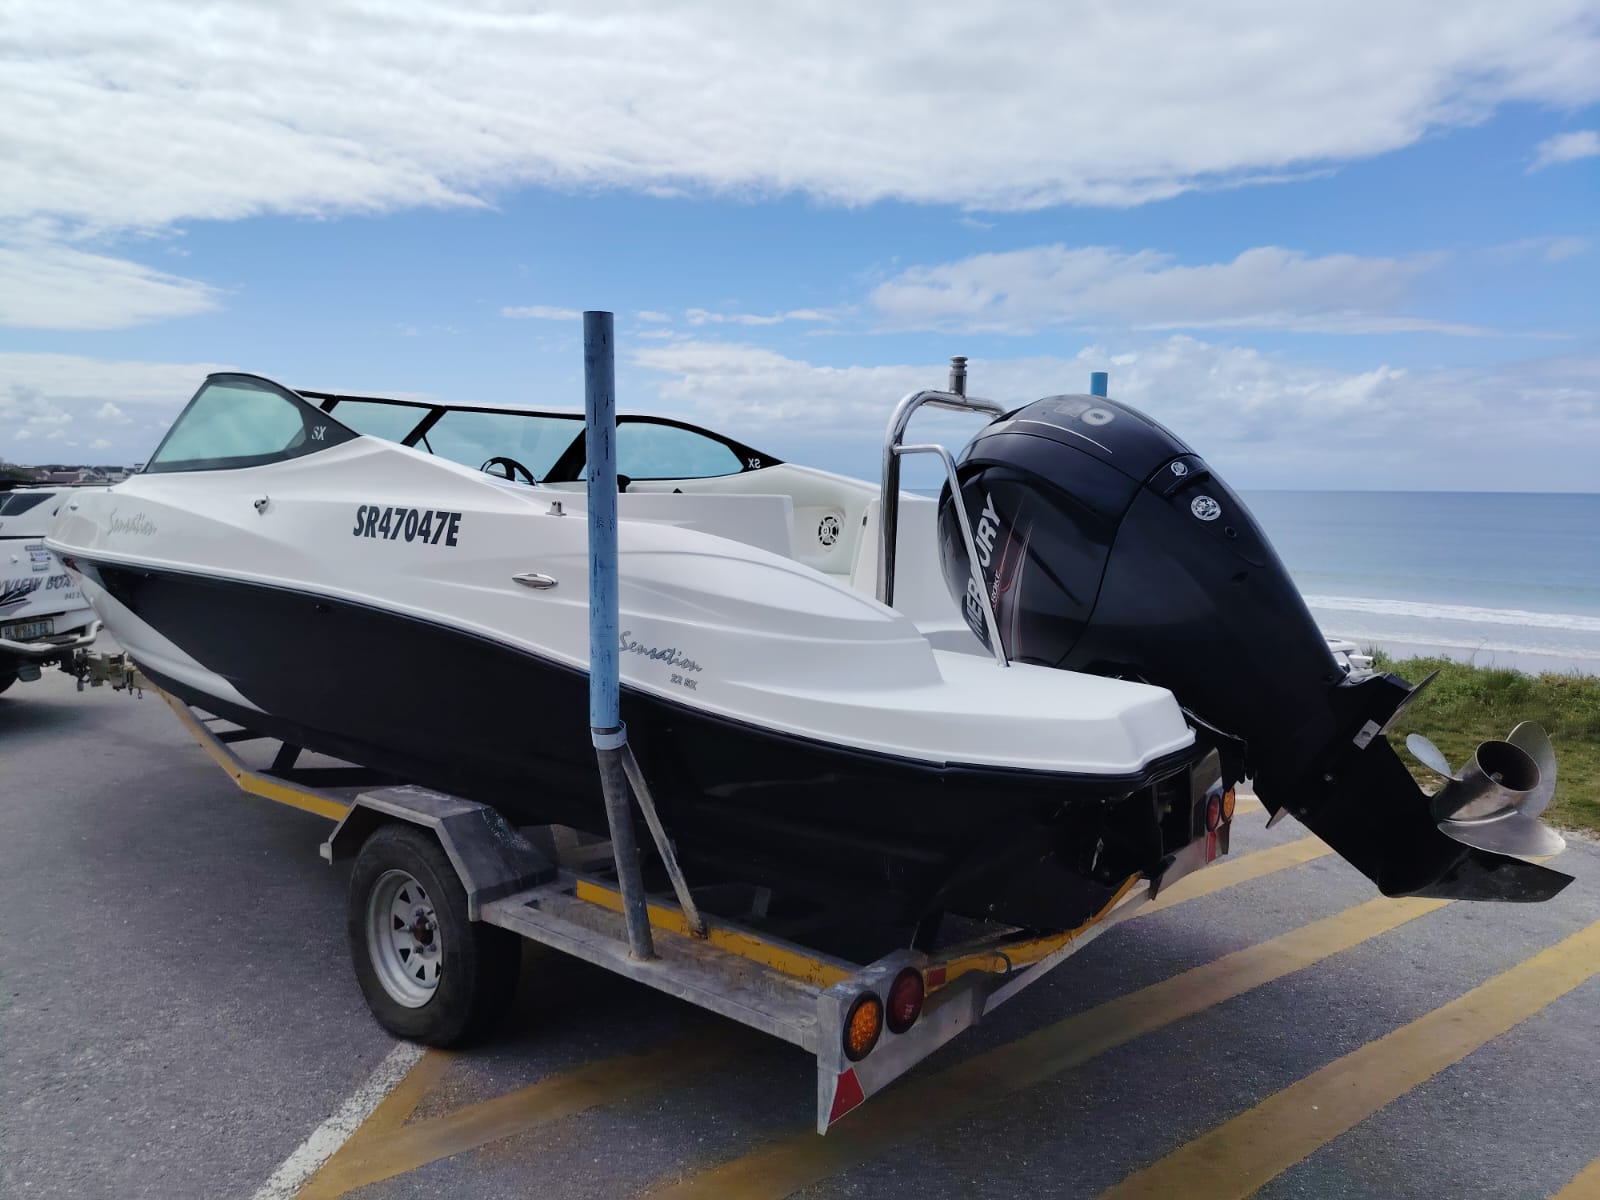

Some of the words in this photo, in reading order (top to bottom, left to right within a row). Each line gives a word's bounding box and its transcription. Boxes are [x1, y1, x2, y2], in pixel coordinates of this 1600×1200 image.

[312, 426, 326, 440] SX
[353, 505, 462, 547] SR47047E
[45, 574, 75, 590] BOA
[966, 491, 1001, 641] MERURY
[619, 630, 703, 672] Sensation
